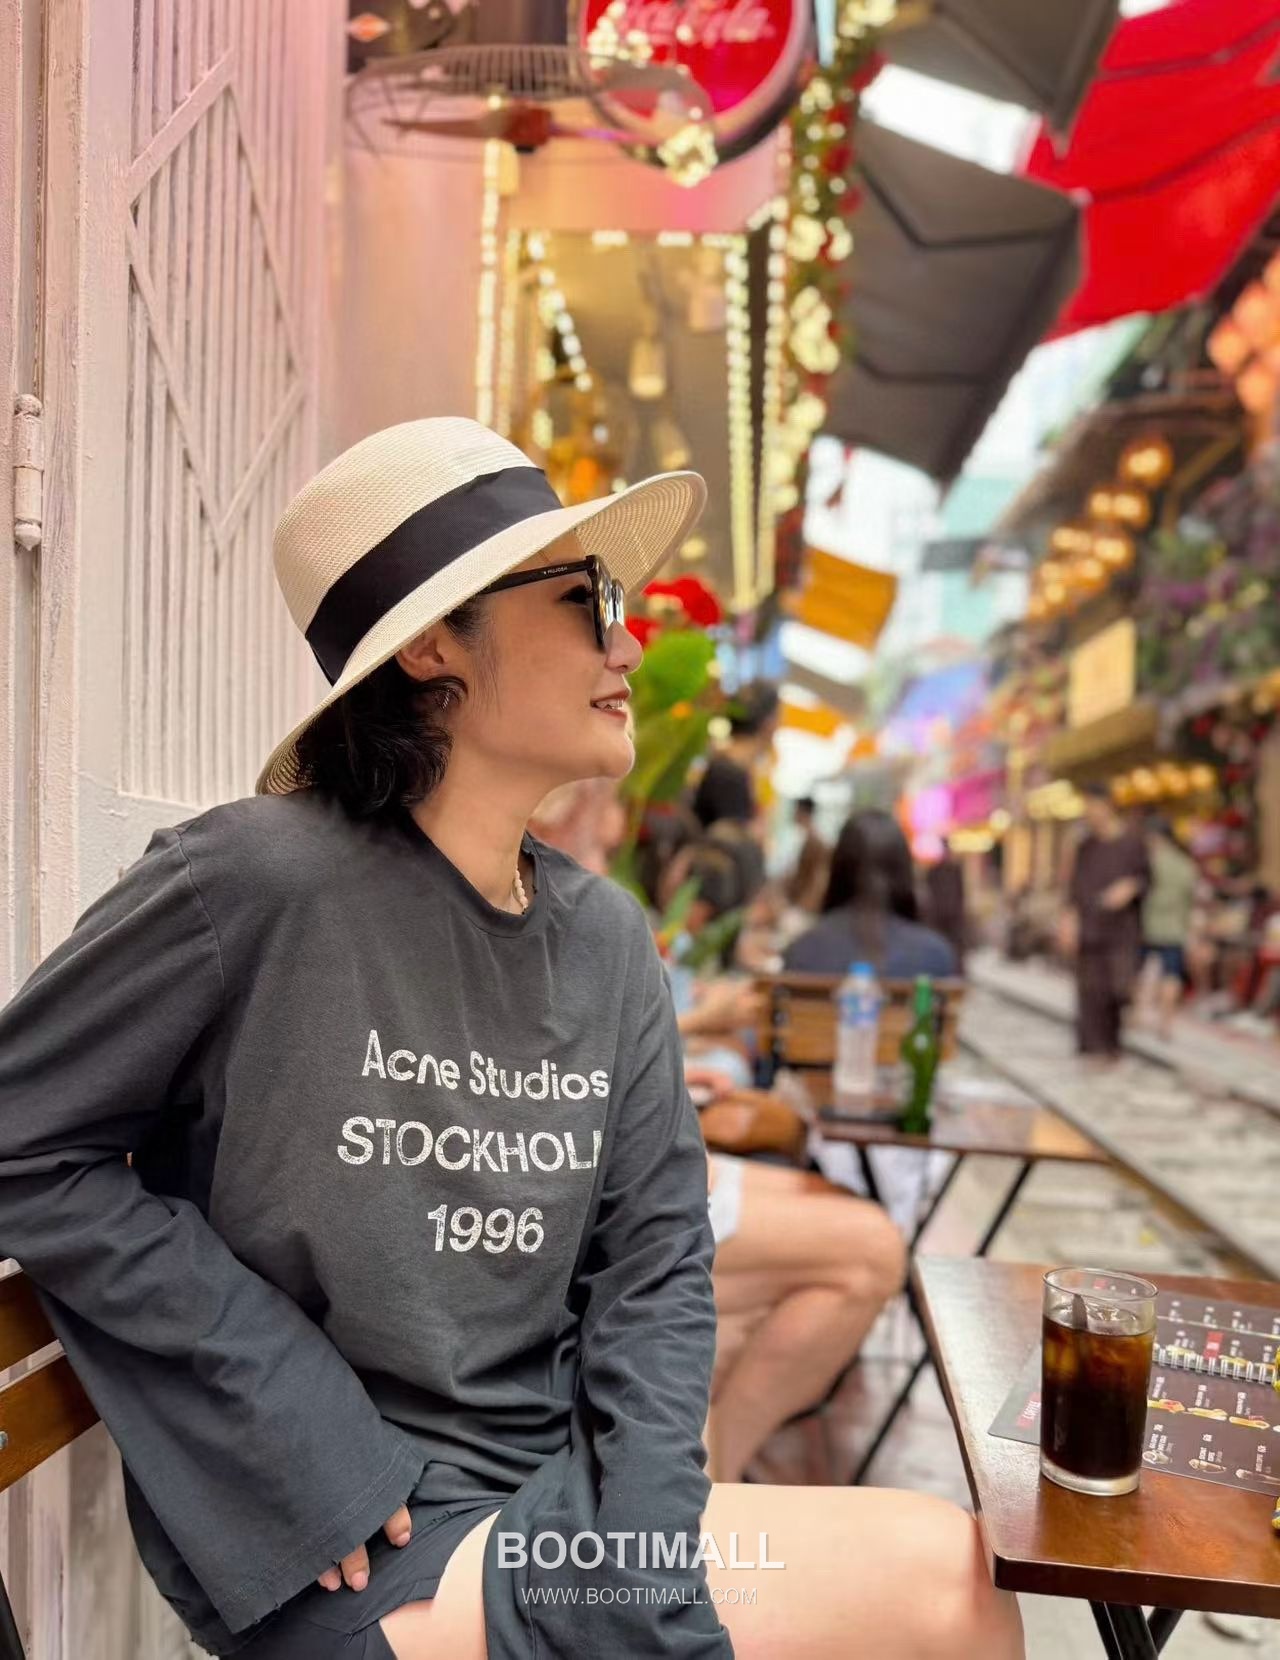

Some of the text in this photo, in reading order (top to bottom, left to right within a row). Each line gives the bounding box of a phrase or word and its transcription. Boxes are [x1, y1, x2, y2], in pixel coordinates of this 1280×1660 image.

[361, 1029, 610, 1100] Acne Studios
[337, 1116, 602, 1173] STOCKHOL
[427, 1204, 545, 1254] 1996
